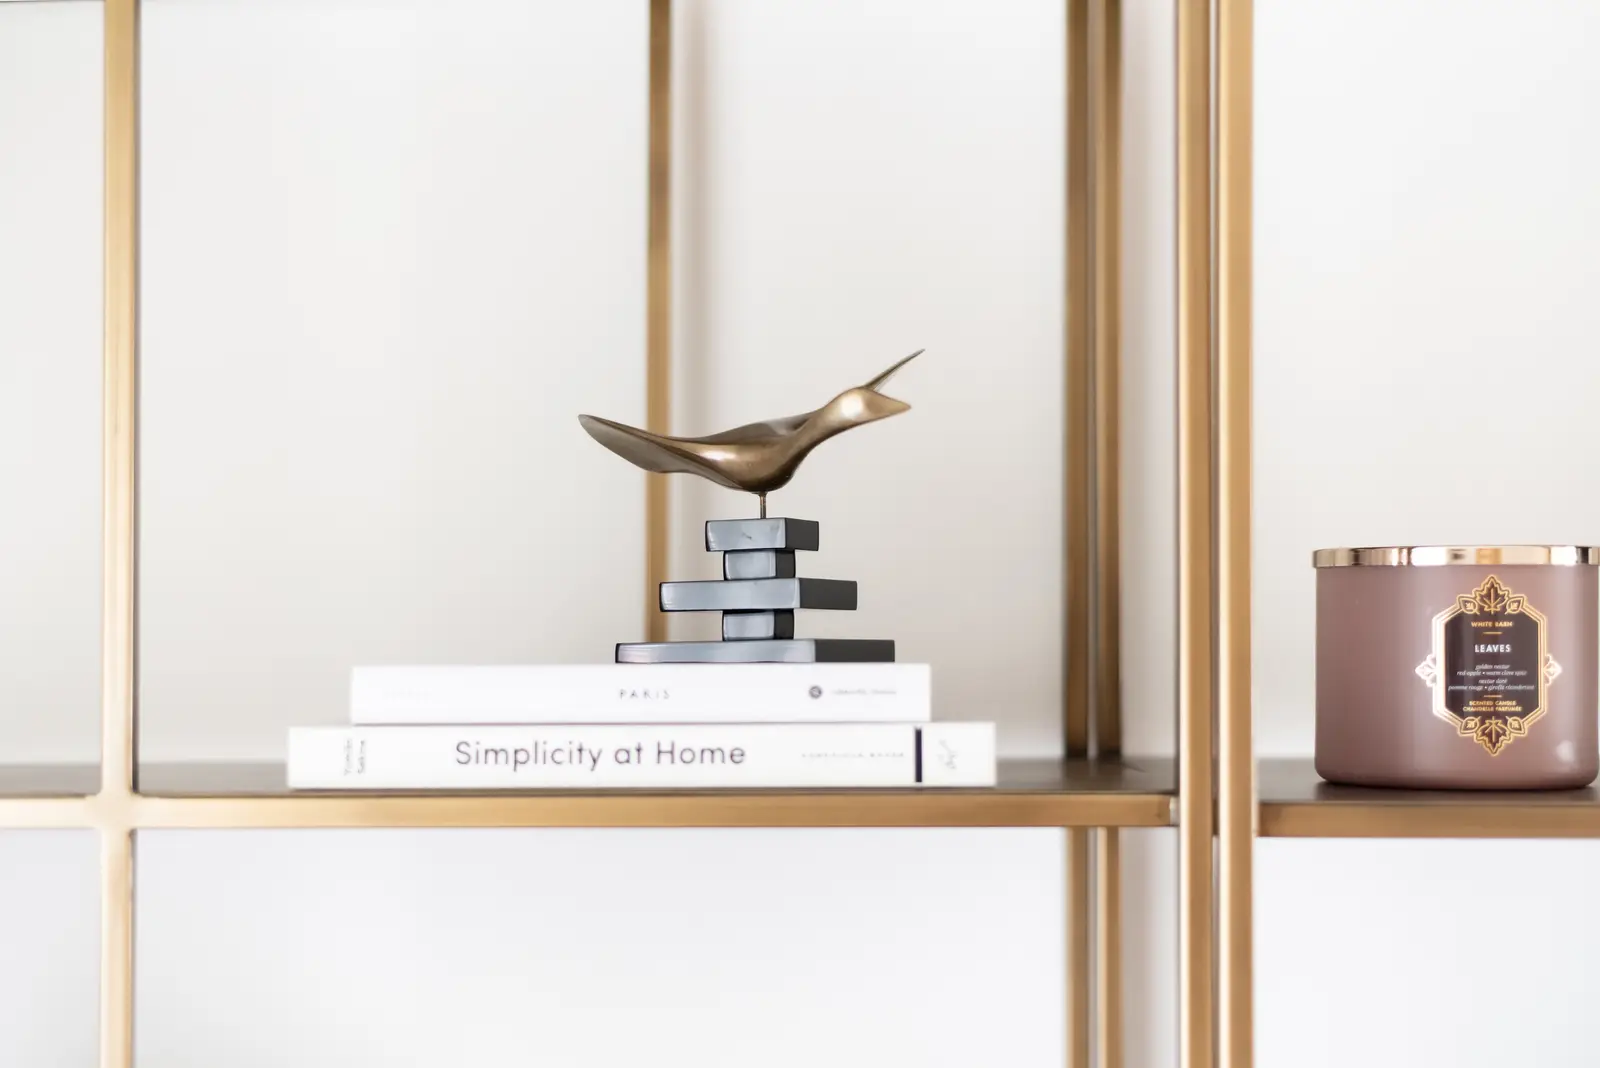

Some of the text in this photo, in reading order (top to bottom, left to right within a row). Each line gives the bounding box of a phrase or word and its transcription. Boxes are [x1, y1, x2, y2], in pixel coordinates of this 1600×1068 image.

[1474, 644, 1512, 653] LEAVES
[619, 688, 671, 700] PARIS
[455, 740, 747, 772] Simplicity at Home
